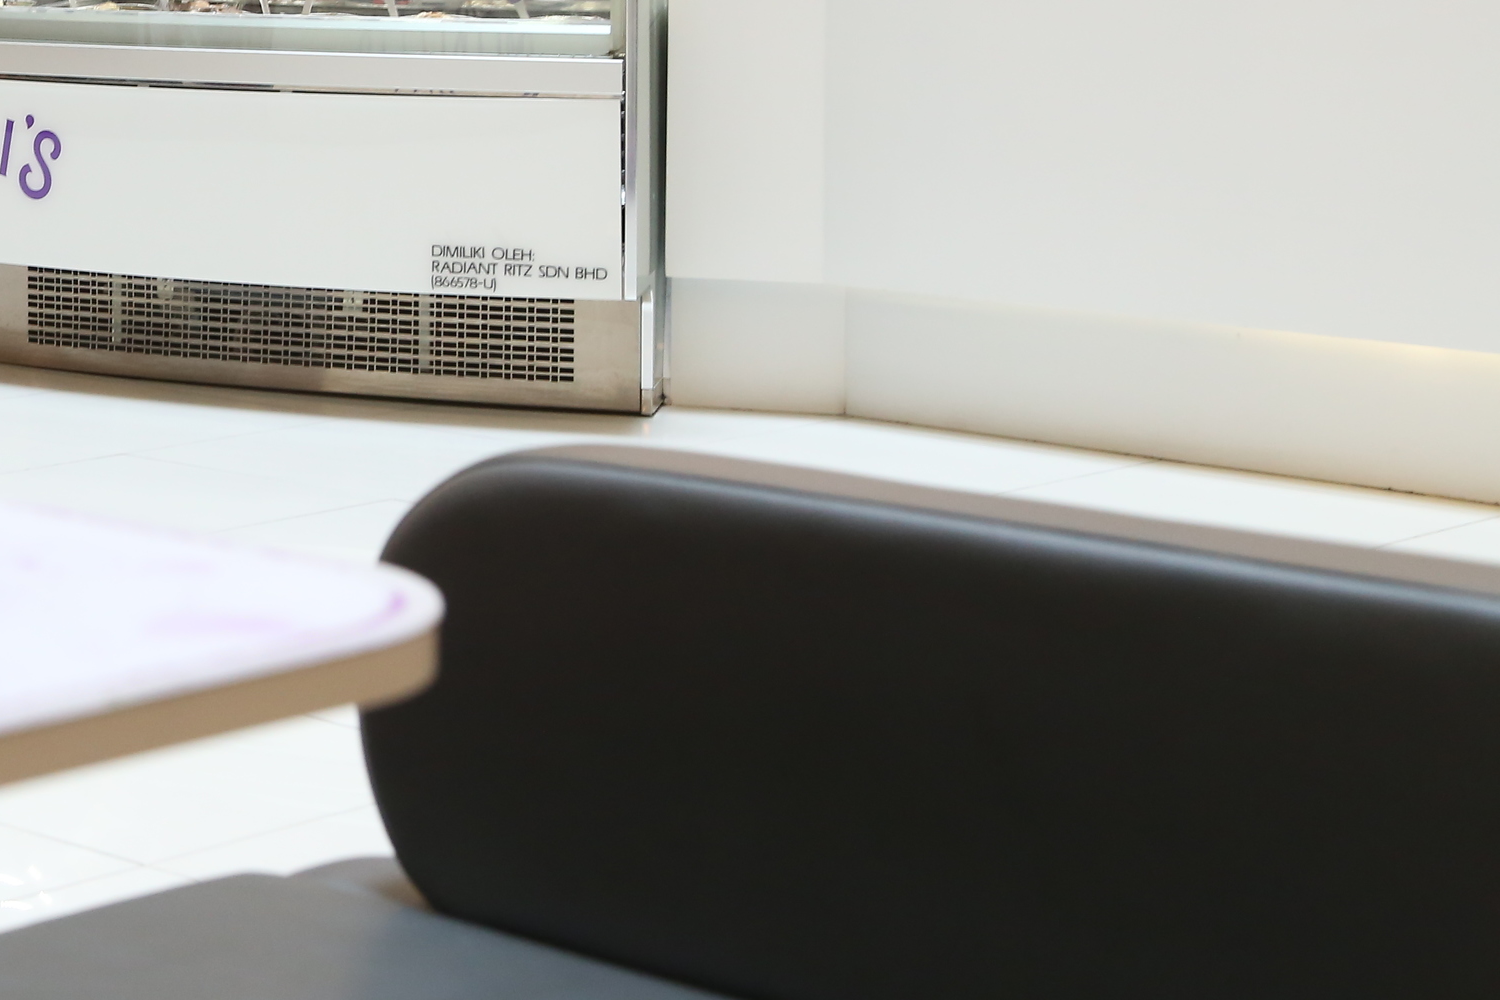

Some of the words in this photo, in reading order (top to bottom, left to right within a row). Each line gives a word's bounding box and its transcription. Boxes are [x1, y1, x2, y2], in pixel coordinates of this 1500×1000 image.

[431, 245, 485, 260] DIMILIKI
[492, 247, 536, 262] OLEH:
[431, 260, 498, 276] RADIANT
[503, 263, 534, 278] RITZ
[539, 265, 570, 280] SDN
[575, 267, 608, 281] BHD
[431, 275, 498, 292] (866578-U)
